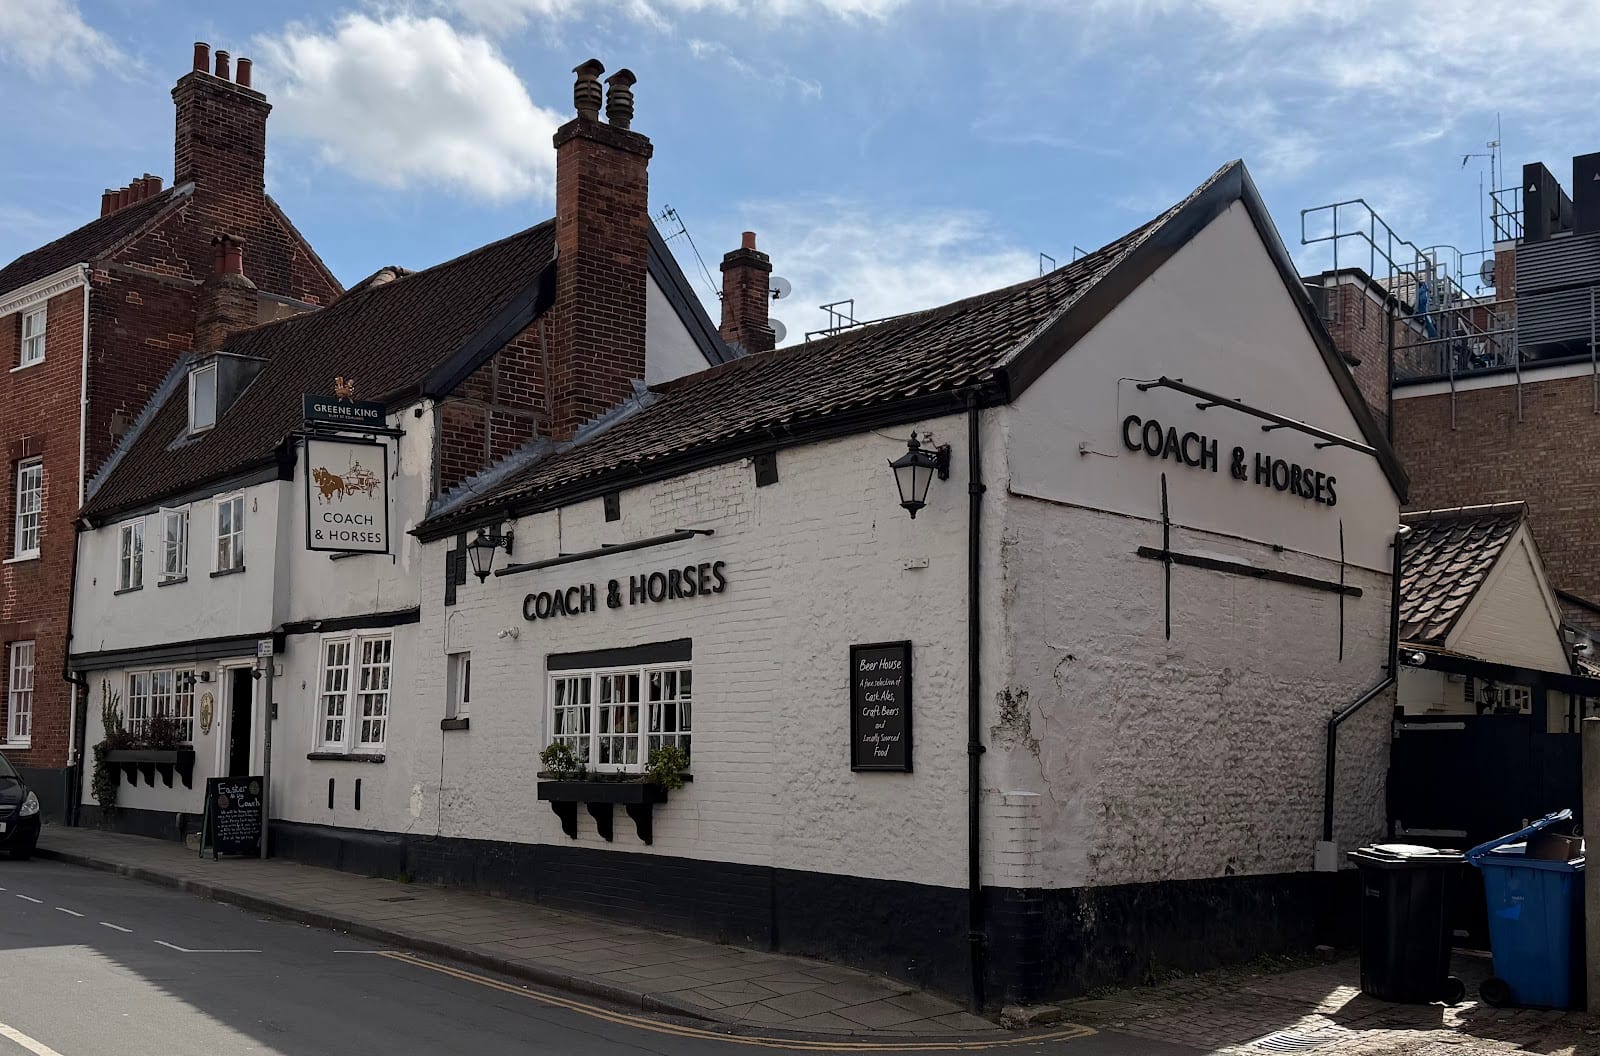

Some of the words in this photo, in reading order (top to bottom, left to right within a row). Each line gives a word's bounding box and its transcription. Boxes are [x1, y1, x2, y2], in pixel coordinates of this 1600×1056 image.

[314, 404, 351, 415] GREENE
[354, 408, 378, 418] KING
[1122, 414, 1218, 473] COACH
[1230, 446, 1248, 482] &
[1255, 452, 1337, 507] HORSES
[323, 512, 373, 526] COACH
[314, 529, 324, 540] &
[329, 529, 382, 543] HORSES
[522, 583, 596, 621] COACH
[606, 578, 622, 609] &
[629, 560, 726, 605] HORSES
[860, 659, 878, 671] Beer
[879, 657, 901, 670] House
[881, 705, 899, 716] Beers
[874, 744, 890, 757] Food
[218, 783, 247, 794] Easter
